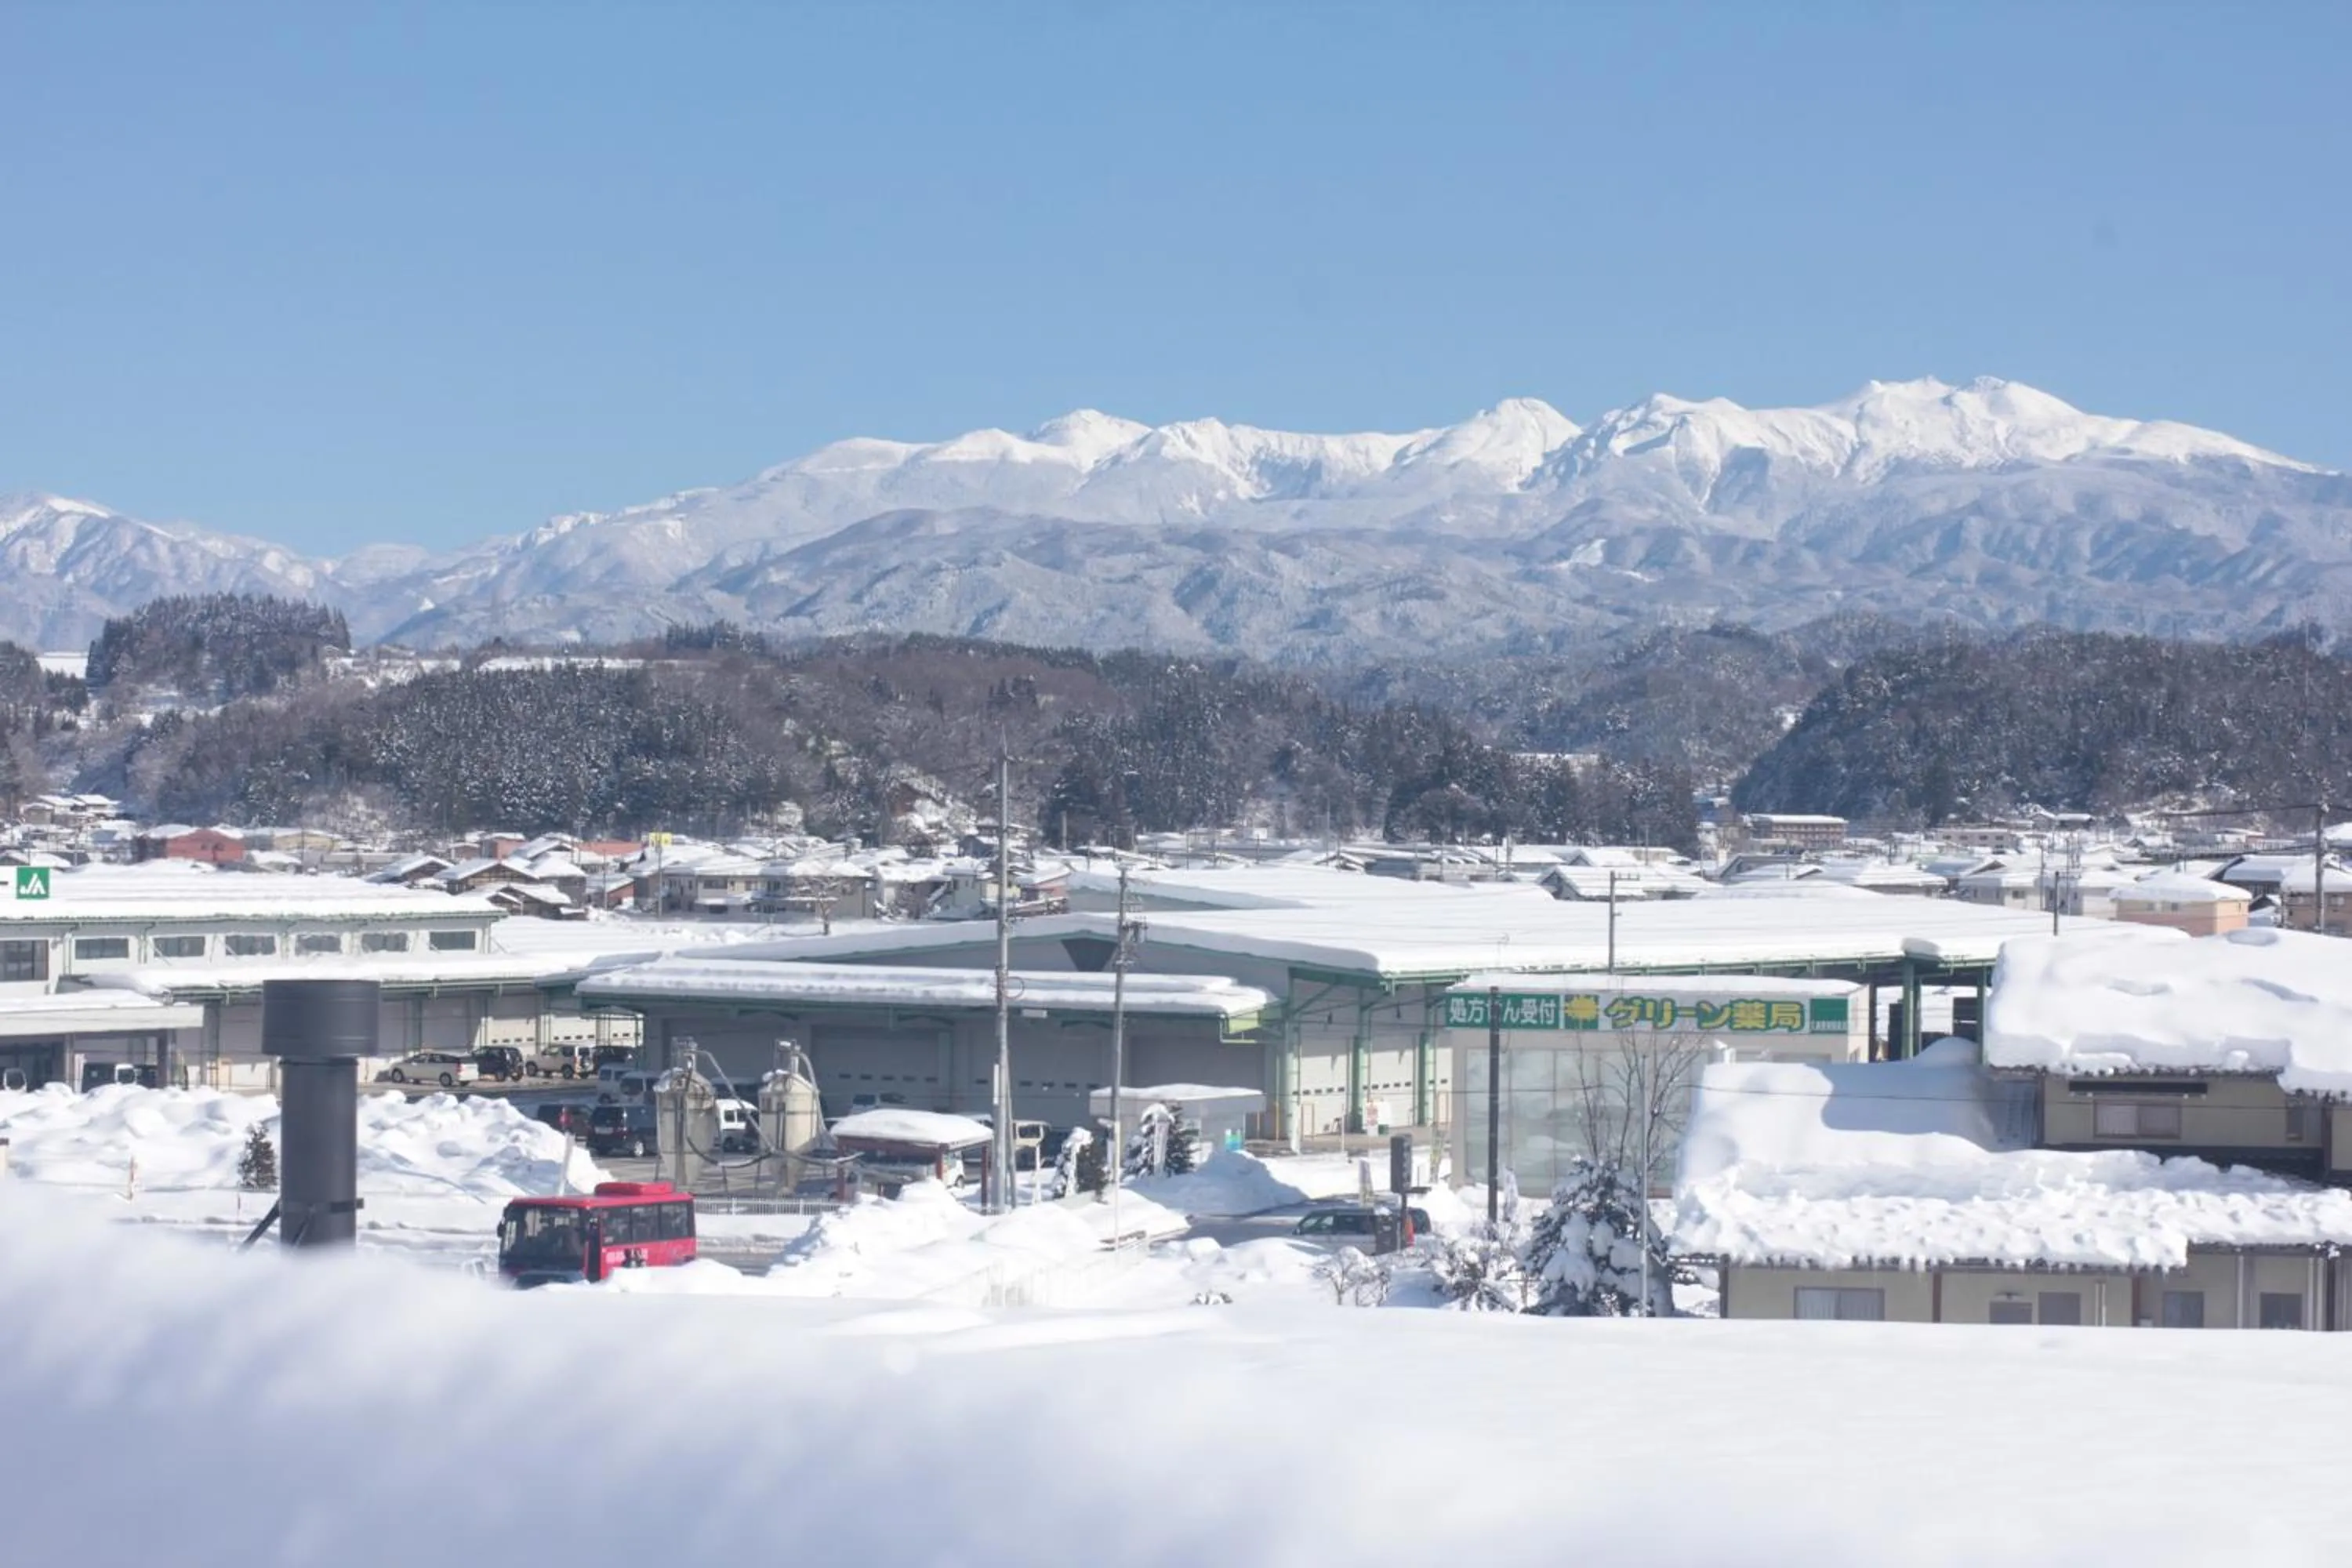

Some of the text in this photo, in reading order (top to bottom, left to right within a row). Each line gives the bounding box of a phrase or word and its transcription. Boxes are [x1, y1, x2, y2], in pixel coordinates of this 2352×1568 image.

[20, 873, 46, 895] JA
[1450, 996, 1555, 1025] 処方ん受付
[1605, 996, 1804, 1031] グリーン薬局
